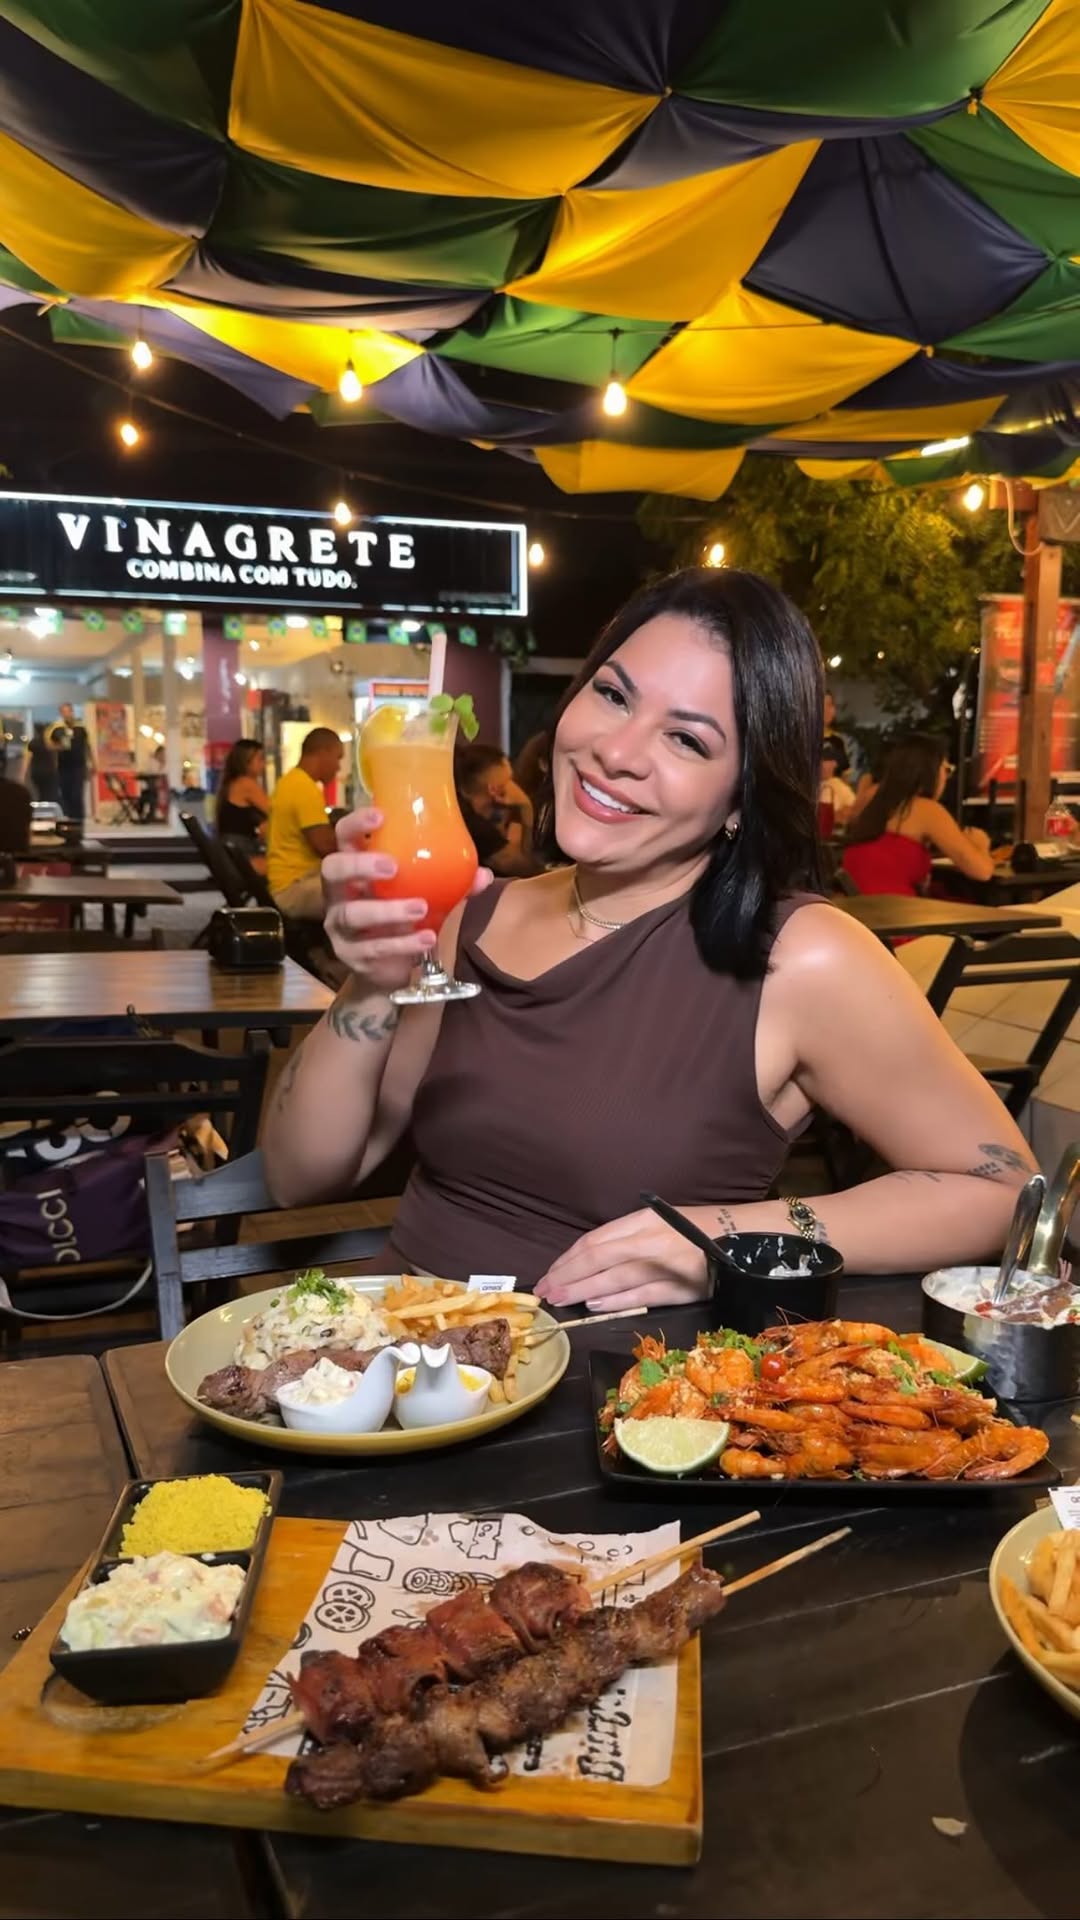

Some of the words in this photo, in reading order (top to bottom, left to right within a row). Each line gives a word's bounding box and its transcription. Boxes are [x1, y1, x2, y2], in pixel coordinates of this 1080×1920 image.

[57, 512, 416, 570] VINAGRETE
[126, 558, 236, 585] COMBINA
[239, 564, 289, 586] COM
[292, 566, 358, 590] TUDO.
